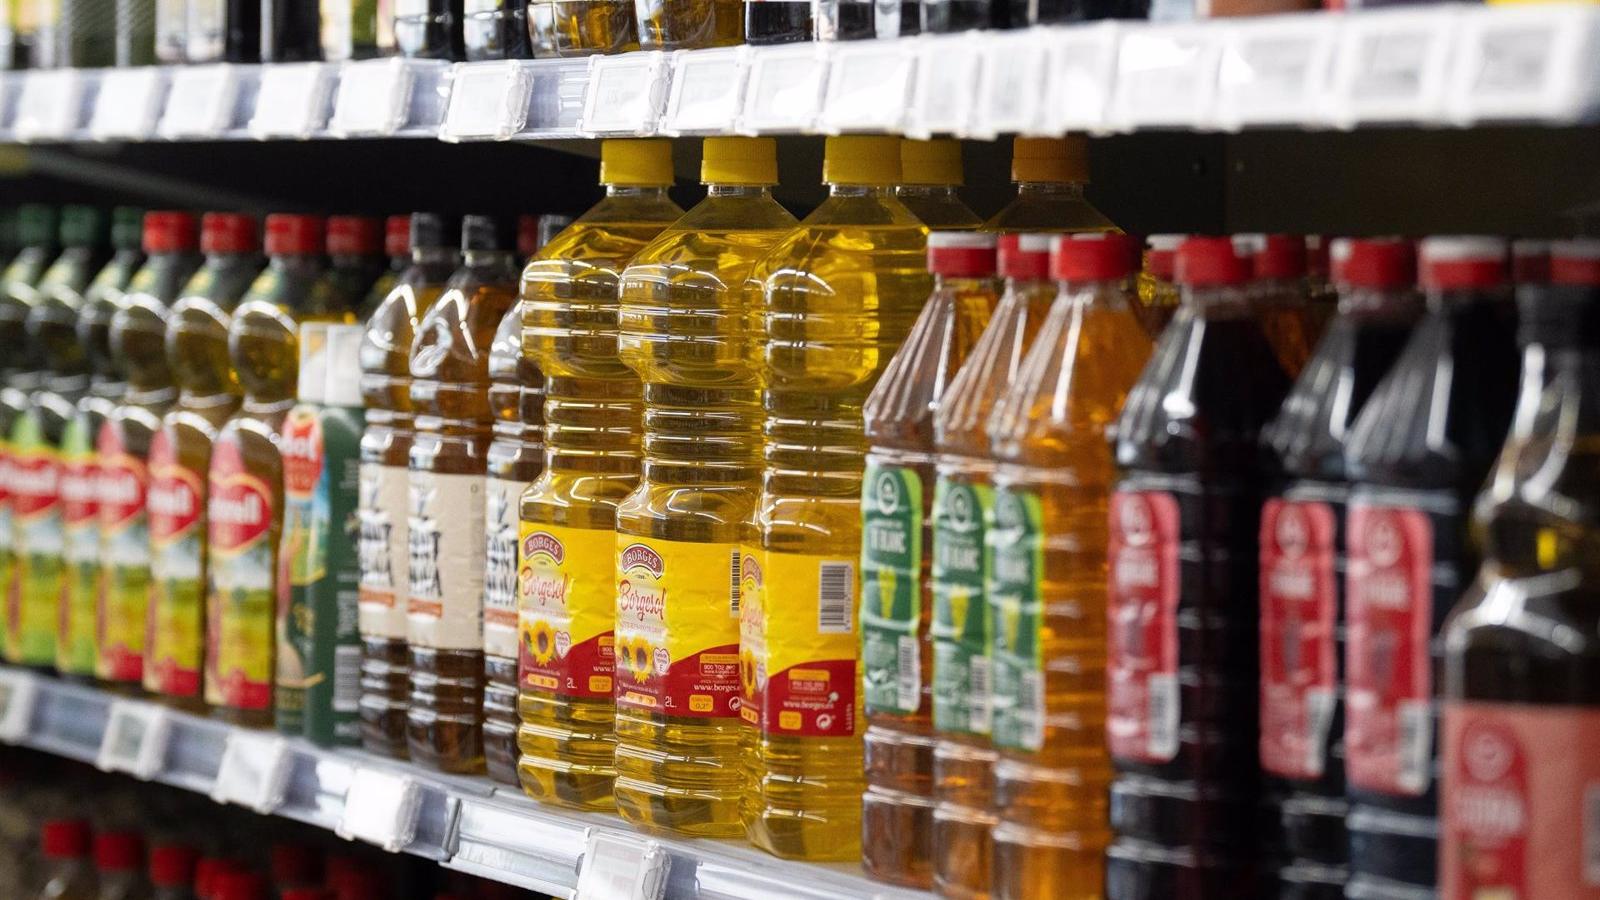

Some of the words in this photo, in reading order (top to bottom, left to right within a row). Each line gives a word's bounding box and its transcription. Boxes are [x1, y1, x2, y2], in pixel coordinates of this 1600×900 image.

[528, 536, 560, 556] BORGES
[627, 549, 659, 569] BORGES
[521, 566, 568, 605] Borgesol
[620, 579, 667, 621] Borgesol
